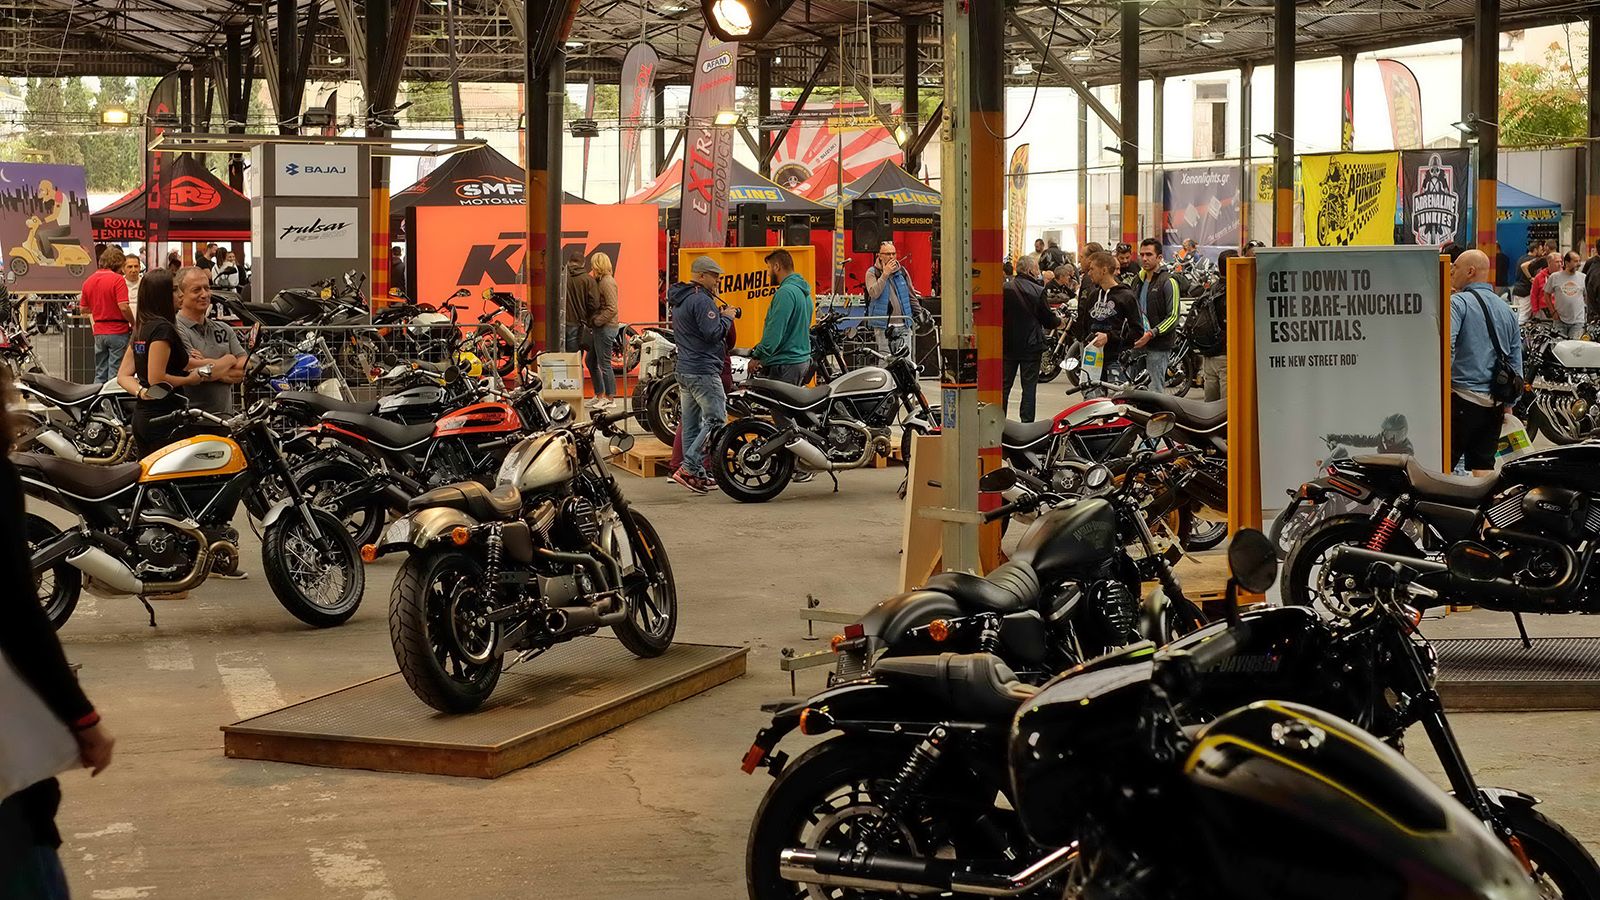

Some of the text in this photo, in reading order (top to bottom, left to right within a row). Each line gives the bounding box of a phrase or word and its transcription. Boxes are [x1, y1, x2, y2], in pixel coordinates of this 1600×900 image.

[706, 56, 728, 70] AFAM
[304, 165, 347, 174] BAJAJ
[714, 129, 732, 210] PRODUCTS
[1181, 171, 1230, 186] Xenonlights.gr
[1348, 167, 1387, 198] ADRENALINE
[459, 198, 527, 206] MOTOSHO
[730, 189, 779, 200] HLINS
[876, 190, 941, 206] HLINS
[1353, 181, 1382, 212] JUNKIES
[1415, 193, 1456, 213] ADRENALINE
[104, 217, 143, 229] ROYAL
[1417, 211, 1453, 227] JUNKIES
[101, 229, 146, 240] ENFIELD
[279, 217, 354, 240] pulsar
[718, 269, 779, 294] CRAMBL
[1268, 269, 1371, 293] GET DOWN TO
[747, 286, 779, 299] DUCA
[1266, 293, 1423, 318] THE BARE-KNUCKLED
[214, 329, 229, 344] 62
[1270, 319, 1366, 343] ESSENTIALS.
[1269, 356, 1286, 368] THE
[1288, 355, 1305, 367] NEW
[1308, 354, 1338, 367] STREET
